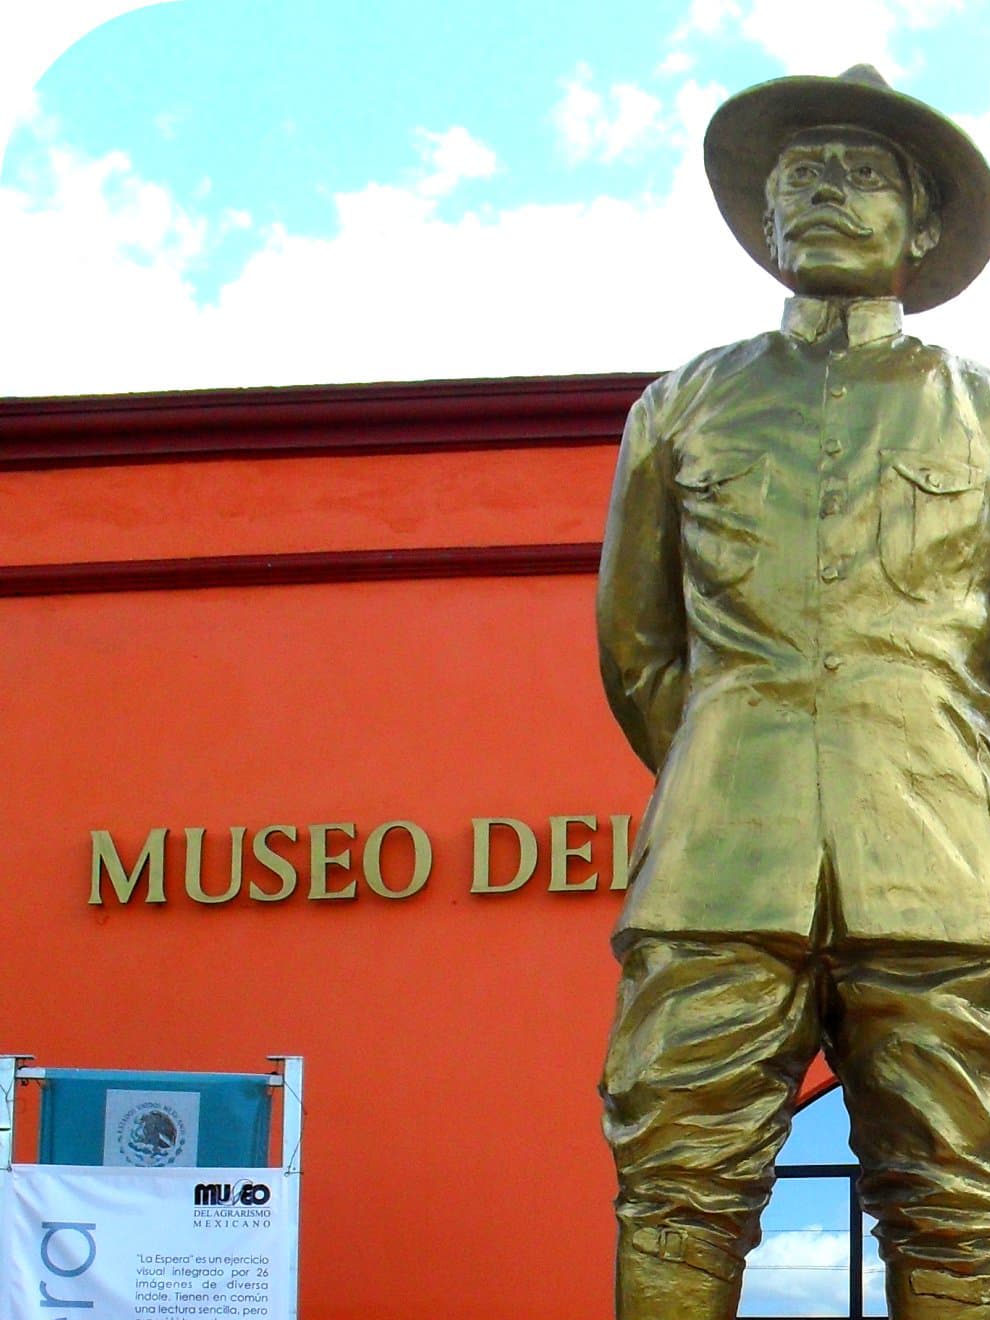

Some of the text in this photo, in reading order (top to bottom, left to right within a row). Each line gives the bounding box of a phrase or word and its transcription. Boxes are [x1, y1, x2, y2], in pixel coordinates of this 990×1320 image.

[87, 819, 433, 904] MUSEO
[194, 1209, 271, 1218] DEL AGRARISMO
[193, 1220, 271, 1228] MEXICANO
[195, 1256, 207, 1264] es
[208, 1256, 221, 1264] un
[224, 1255, 269, 1266] ejercicio
[136, 1267, 269, 1278] visual integrado por 26
[135, 1279, 269, 1290] imágenes de diversa
[175, 1292, 209, 1301] Tienen
[213, 1294, 227, 1302] en
[230, 1292, 268, 1302] común
[135, 1306, 156, 1314] una
[158, 1305, 196, 1314] lectura
[242, 1307, 268, 1316] pero
